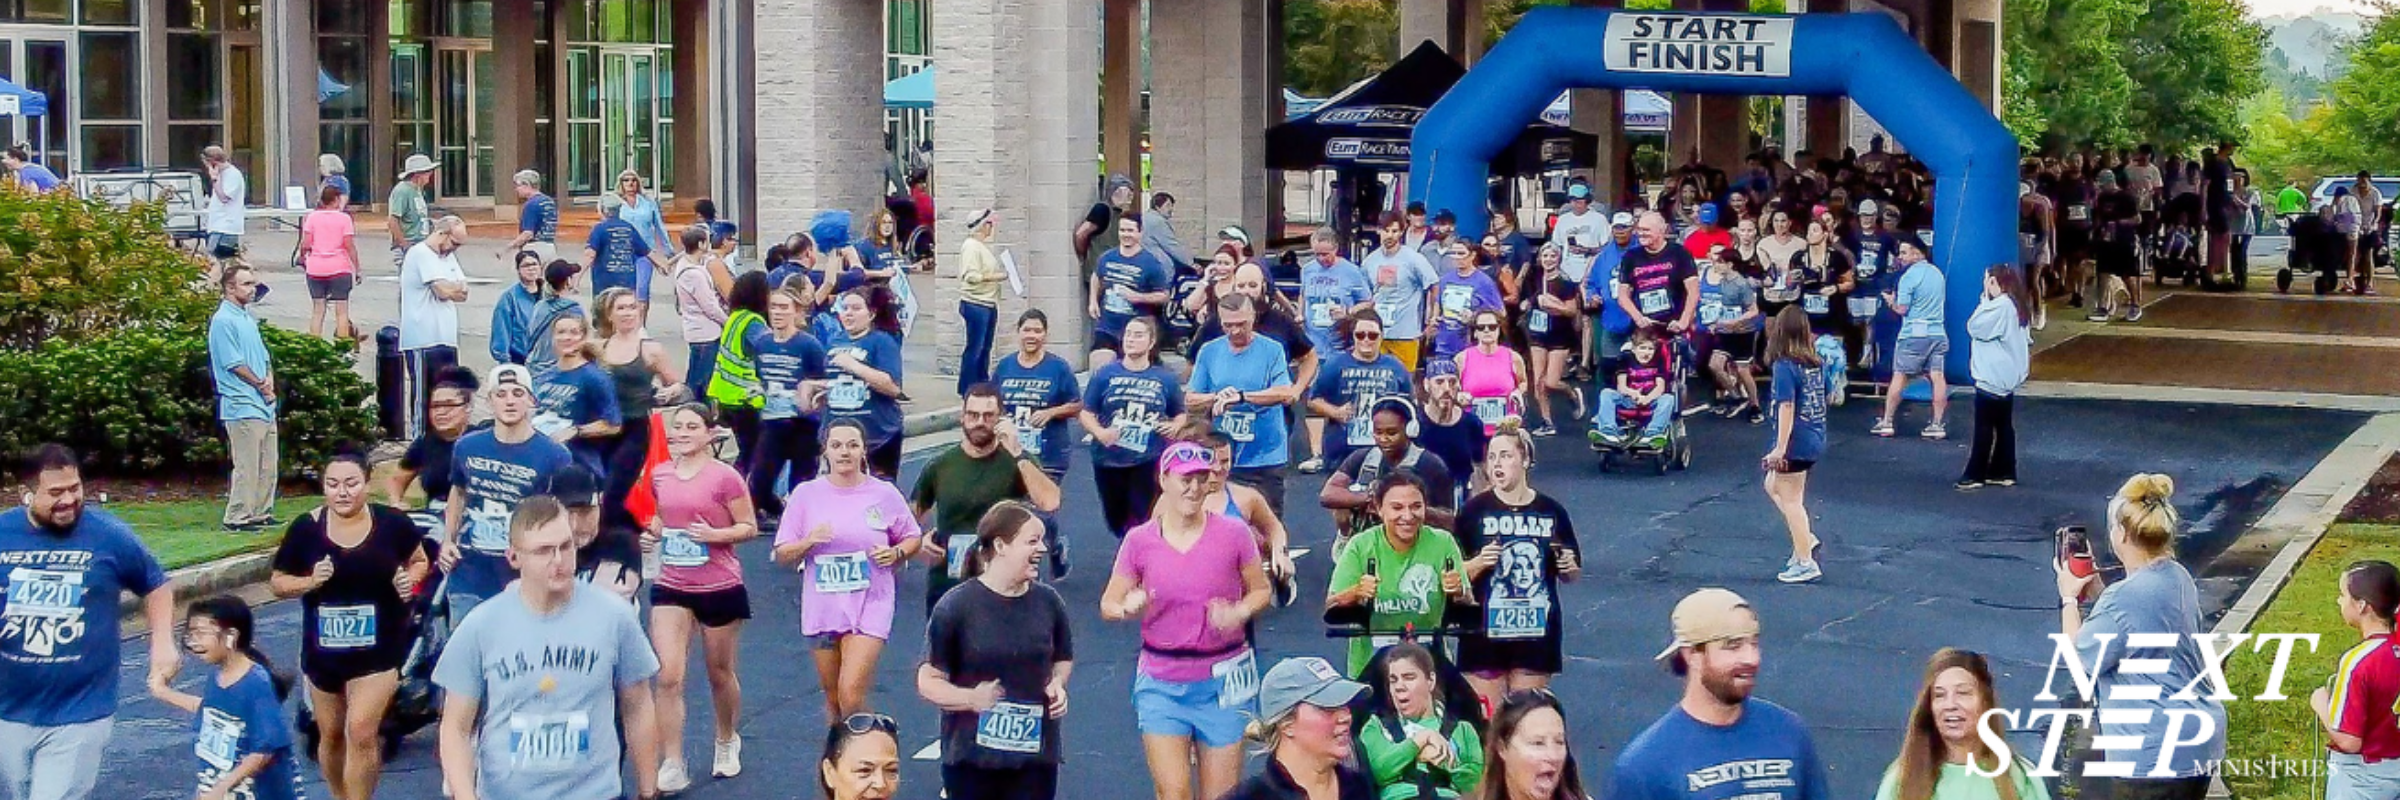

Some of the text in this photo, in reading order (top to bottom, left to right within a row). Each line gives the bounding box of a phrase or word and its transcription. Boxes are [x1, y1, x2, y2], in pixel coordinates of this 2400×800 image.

[1632, 16, 1766, 41] START
[1628, 42, 1765, 72] FINISH
[1483, 516, 1553, 537] DOLLY
[819, 560, 863, 583] 4074
[16, 581, 73, 607] 4220
[323, 616, 368, 638] 4027
[1494, 609, 1538, 629] 4263
[541, 645, 599, 675] ARMY
[984, 714, 1037, 740] 4052
